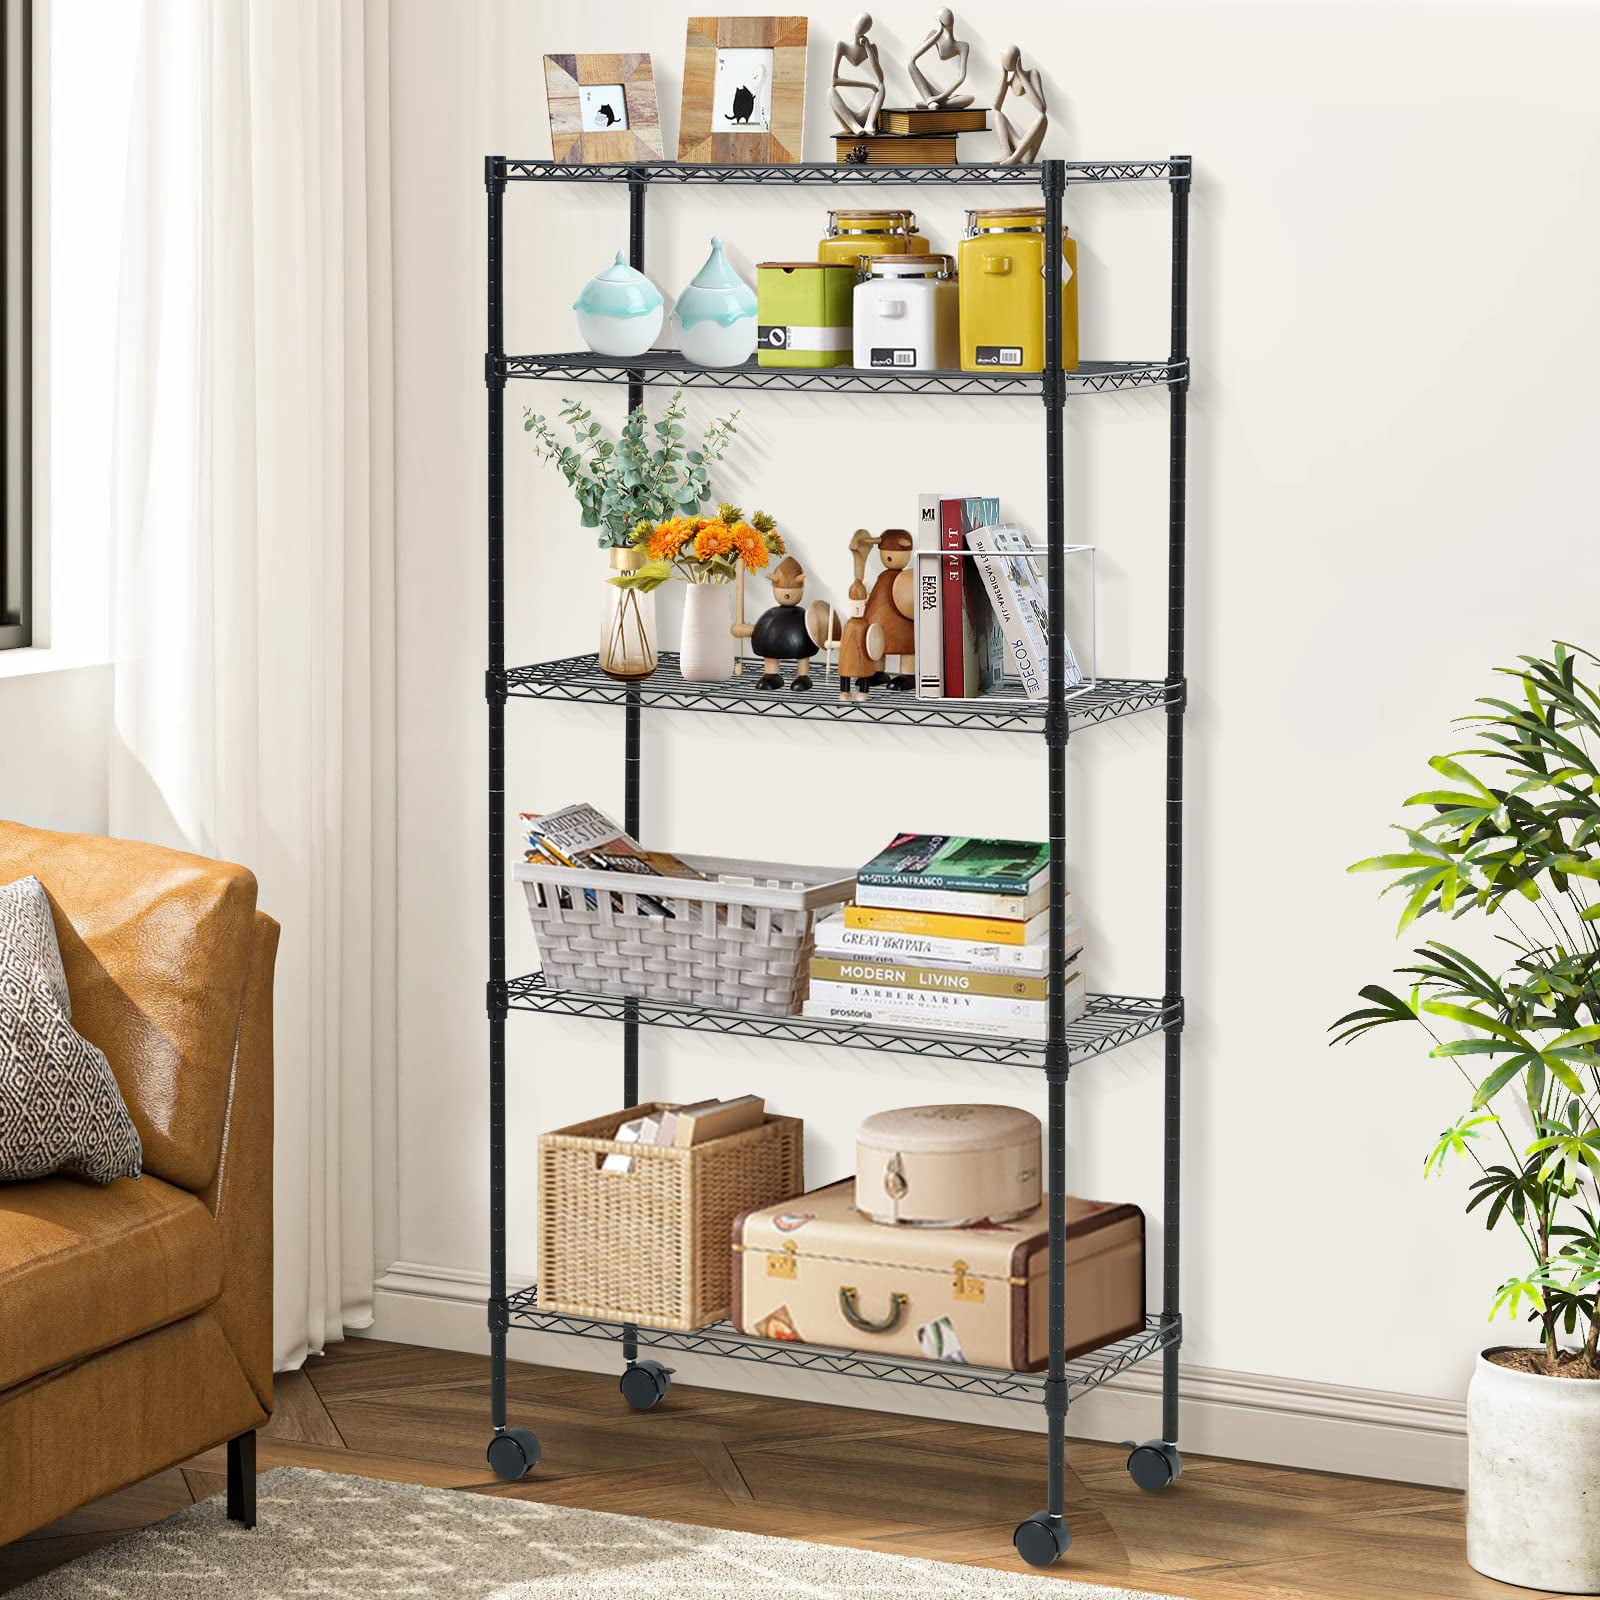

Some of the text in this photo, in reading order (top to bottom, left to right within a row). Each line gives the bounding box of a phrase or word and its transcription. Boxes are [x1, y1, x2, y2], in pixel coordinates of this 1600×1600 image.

[840, 965, 970, 988] MODERN LIVING
[830, 1007, 872, 1020] prostoria
